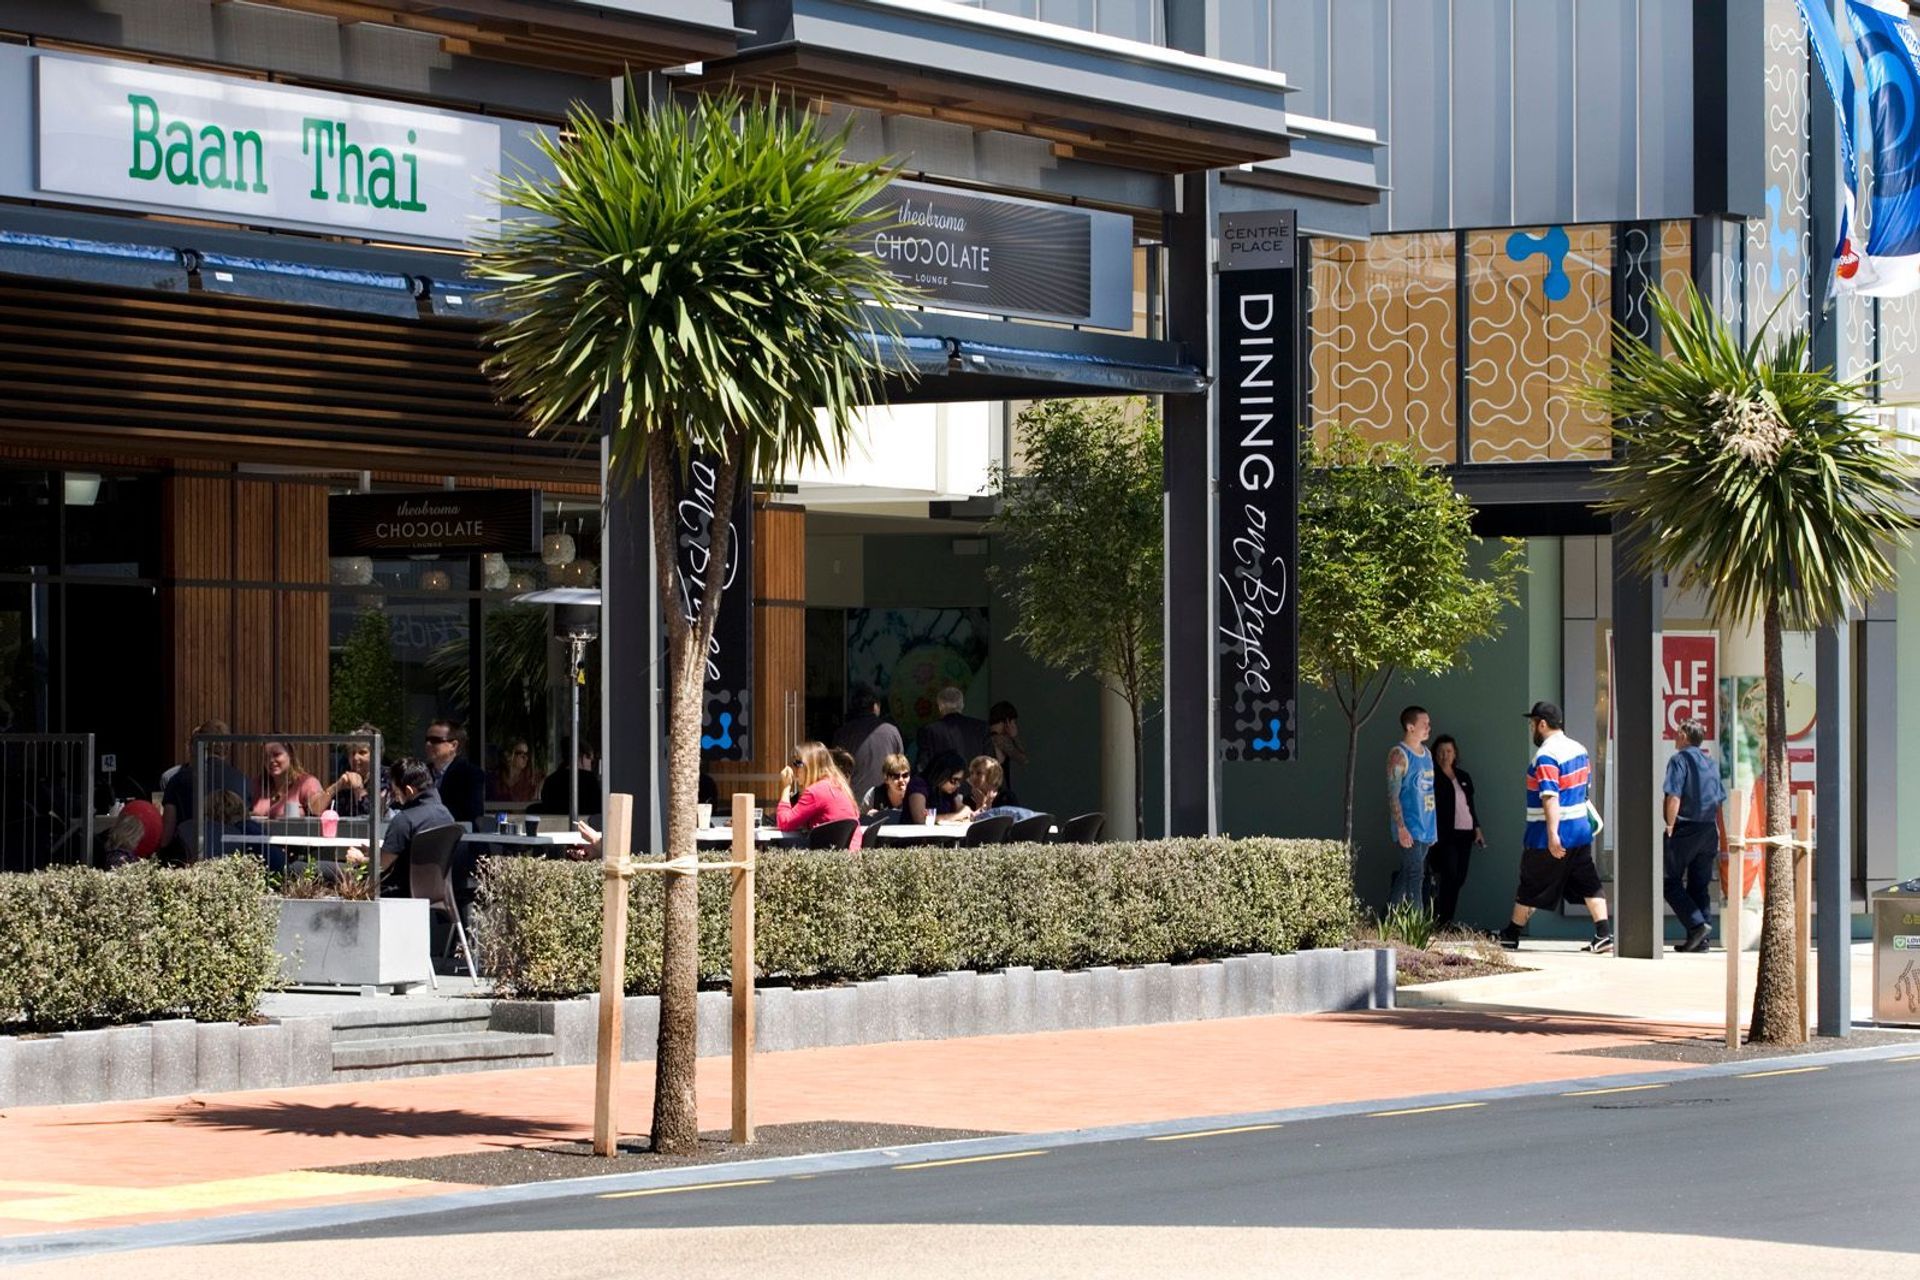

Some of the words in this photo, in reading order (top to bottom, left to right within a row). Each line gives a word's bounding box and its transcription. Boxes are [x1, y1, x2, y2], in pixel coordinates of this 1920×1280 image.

[128, 94, 268, 194] Baan
[302, 117, 427, 212] Thai
[898, 199, 967, 232] theobroma
[1224, 226, 1289, 240] CENTRE
[1231, 240, 1284, 253] PLACE
[915, 273, 948, 285] LOUNGE
[1239, 294, 1274, 491] DINING
[397, 500, 460, 517] theobroma
[1233, 504, 1266, 565] on
[1219, 556, 1287, 693] Bryce
